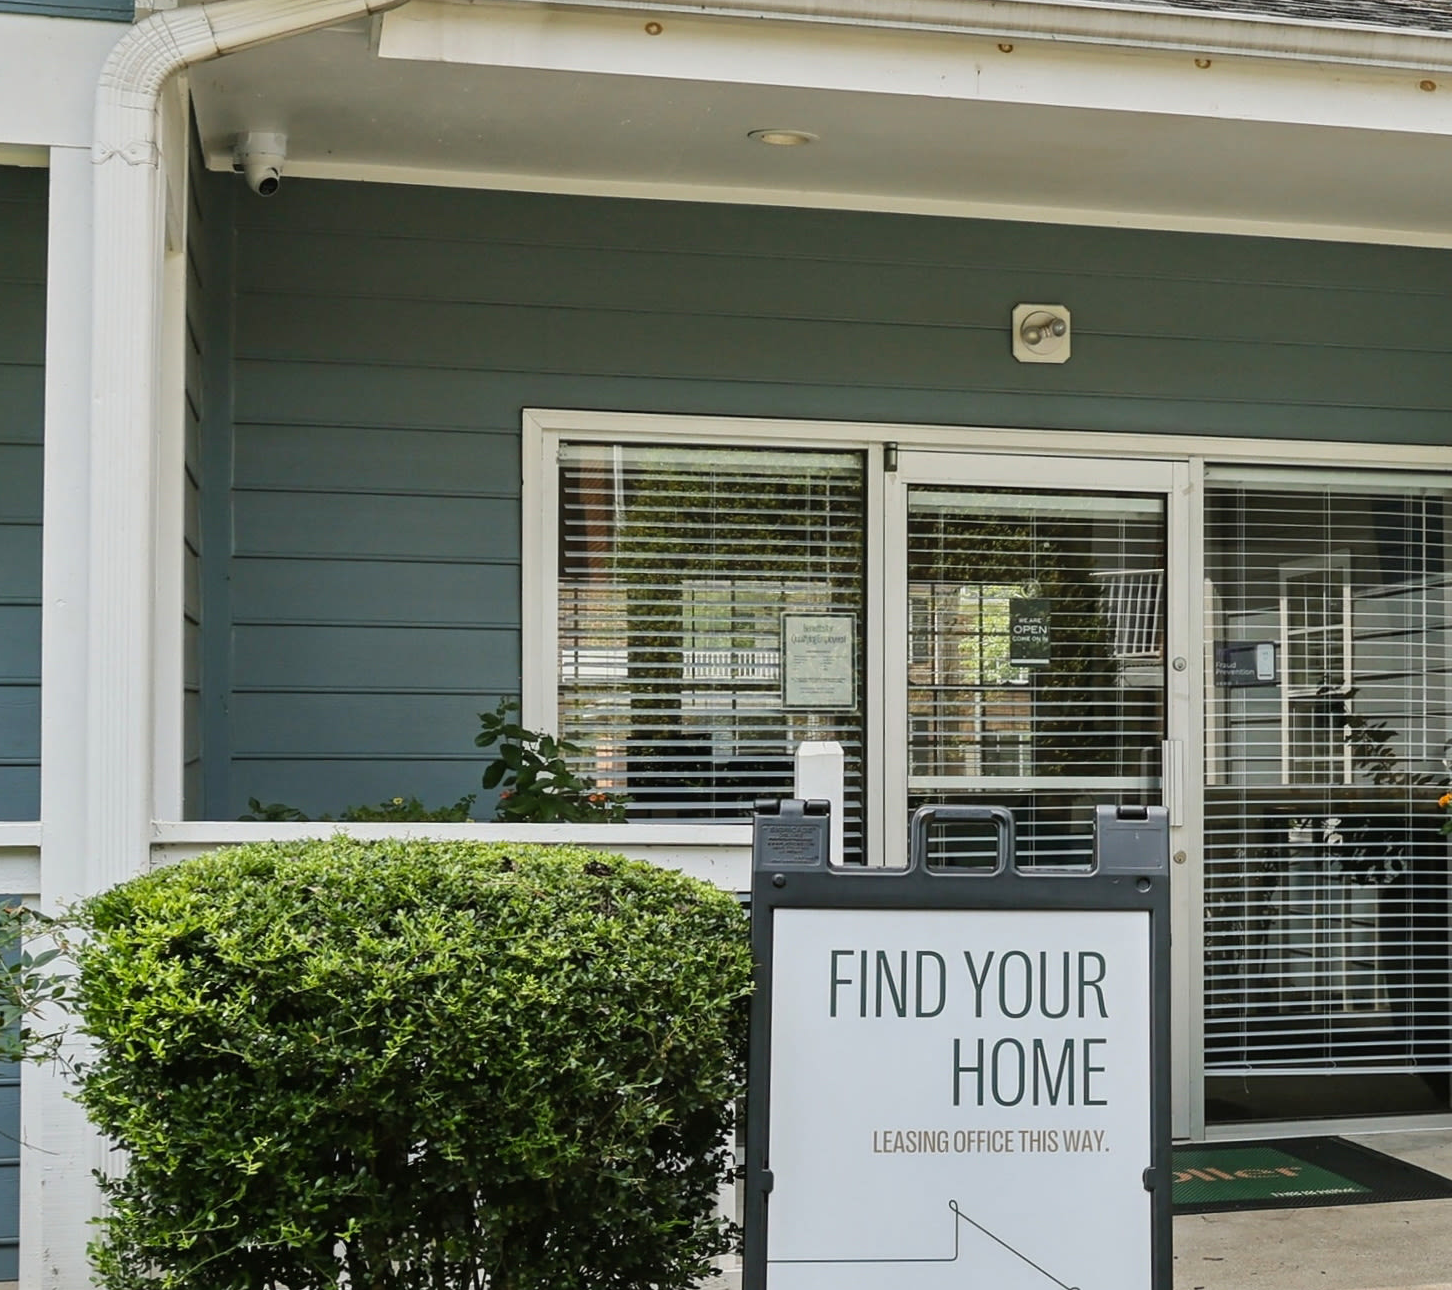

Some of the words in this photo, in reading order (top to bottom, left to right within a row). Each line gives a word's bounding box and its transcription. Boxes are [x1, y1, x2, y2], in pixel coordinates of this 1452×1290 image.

[1013, 625, 1047, 634] OPEN
[830, 950, 946, 1017] FIND
[964, 950, 1109, 1019] YOUR
[953, 1037, 1108, 1106] HOME
[873, 1130, 948, 1153] LEASING
[953, 1130, 1014, 1153] OFFICE
[1018, 1130, 1059, 1153] THIS
[1063, 1130, 1110, 1152] WAY.
